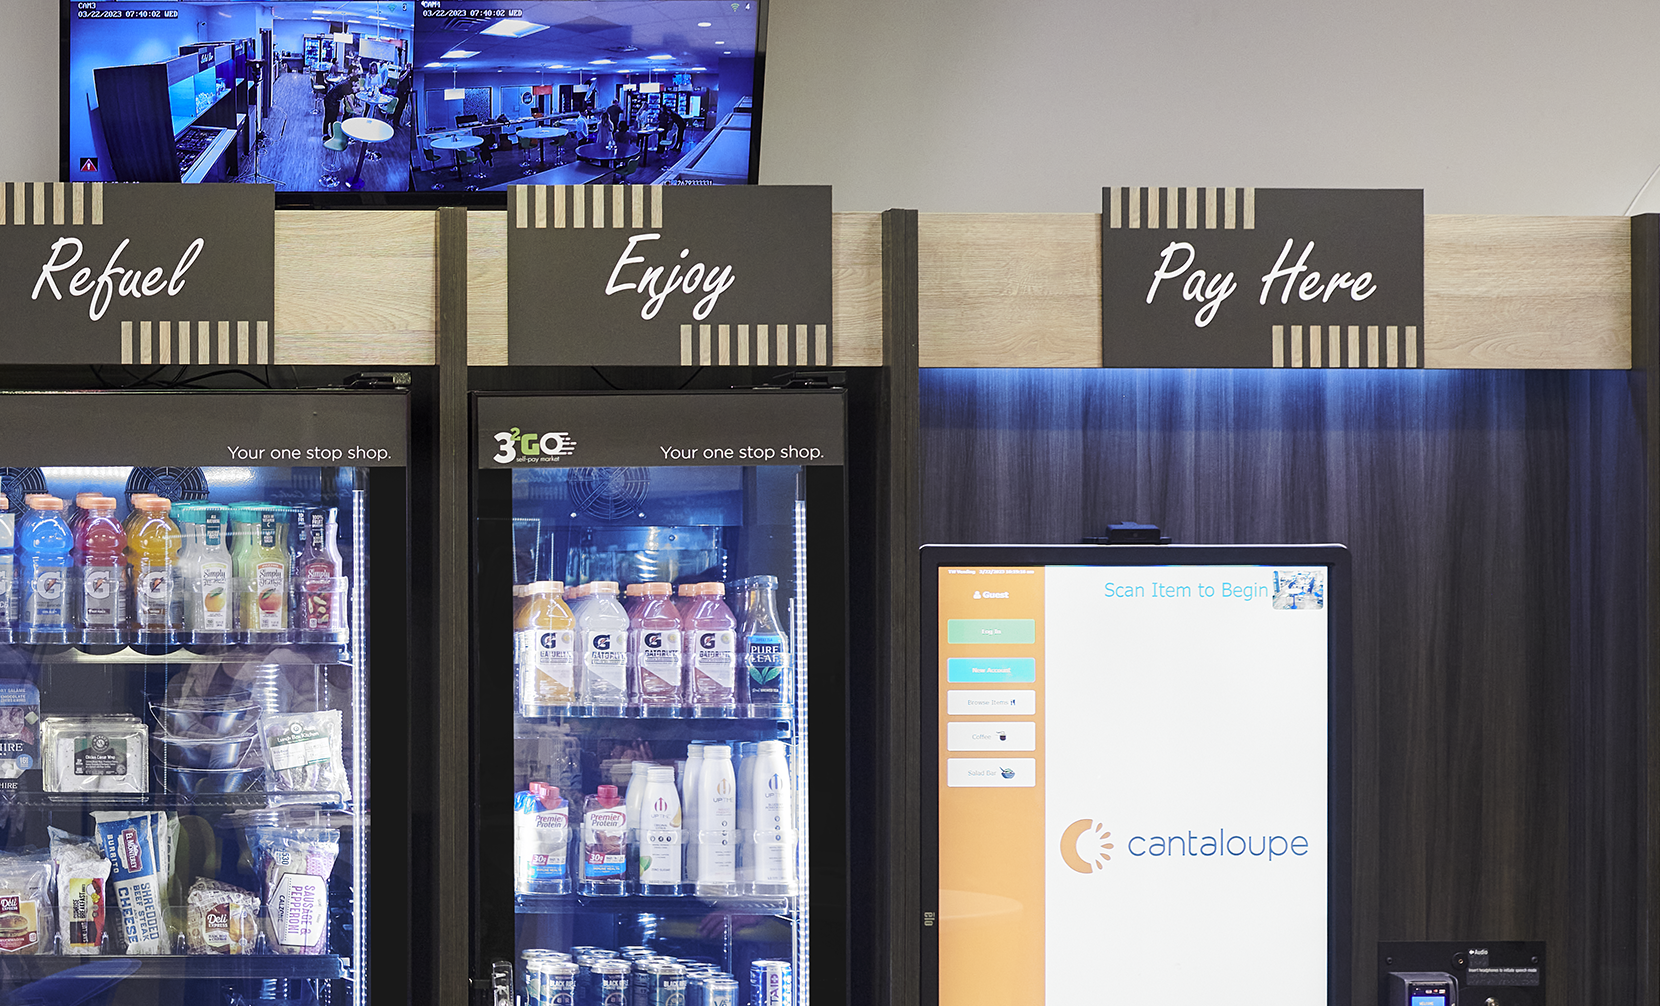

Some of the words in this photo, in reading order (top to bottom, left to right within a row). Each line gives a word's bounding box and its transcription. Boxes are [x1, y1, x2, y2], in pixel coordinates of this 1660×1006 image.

[31, 236, 205, 322] Refuel
[605, 233, 736, 320] Enjoy
[1146, 241, 1237, 327] Pay
[1259, 238, 1377, 305] Here
[227, 446, 265, 460] Your
[270, 449, 301, 460] one
[306, 447, 343, 463] stop
[347, 446, 392, 463] shop.
[660, 446, 699, 460] Your
[703, 447, 734, 460] one
[739, 446, 775, 463] stop
[780, 445, 824, 463] shop.
[982, 591, 1009, 599] Guest
[1104, 582, 1144, 598] Scan
[1152, 582, 1191, 598] Item
[1198, 583, 1215, 598] to
[1222, 581, 1269, 602] Begin
[750, 645, 779, 654] PURE
[590, 813, 621, 823] Premier
[591, 818, 620, 827] Protein
[106, 834, 120, 874] BURRITO
[1128, 828, 1309, 861] cantaloupe
[118, 887, 139, 944] CHEESE
[133, 884, 142, 906] BEEF
[138, 909, 149, 942] STEAK
[140, 882, 160, 940] SHREDDED
[207, 913, 228, 924] Deli
[288, 885, 302, 935] PEPPERONI
